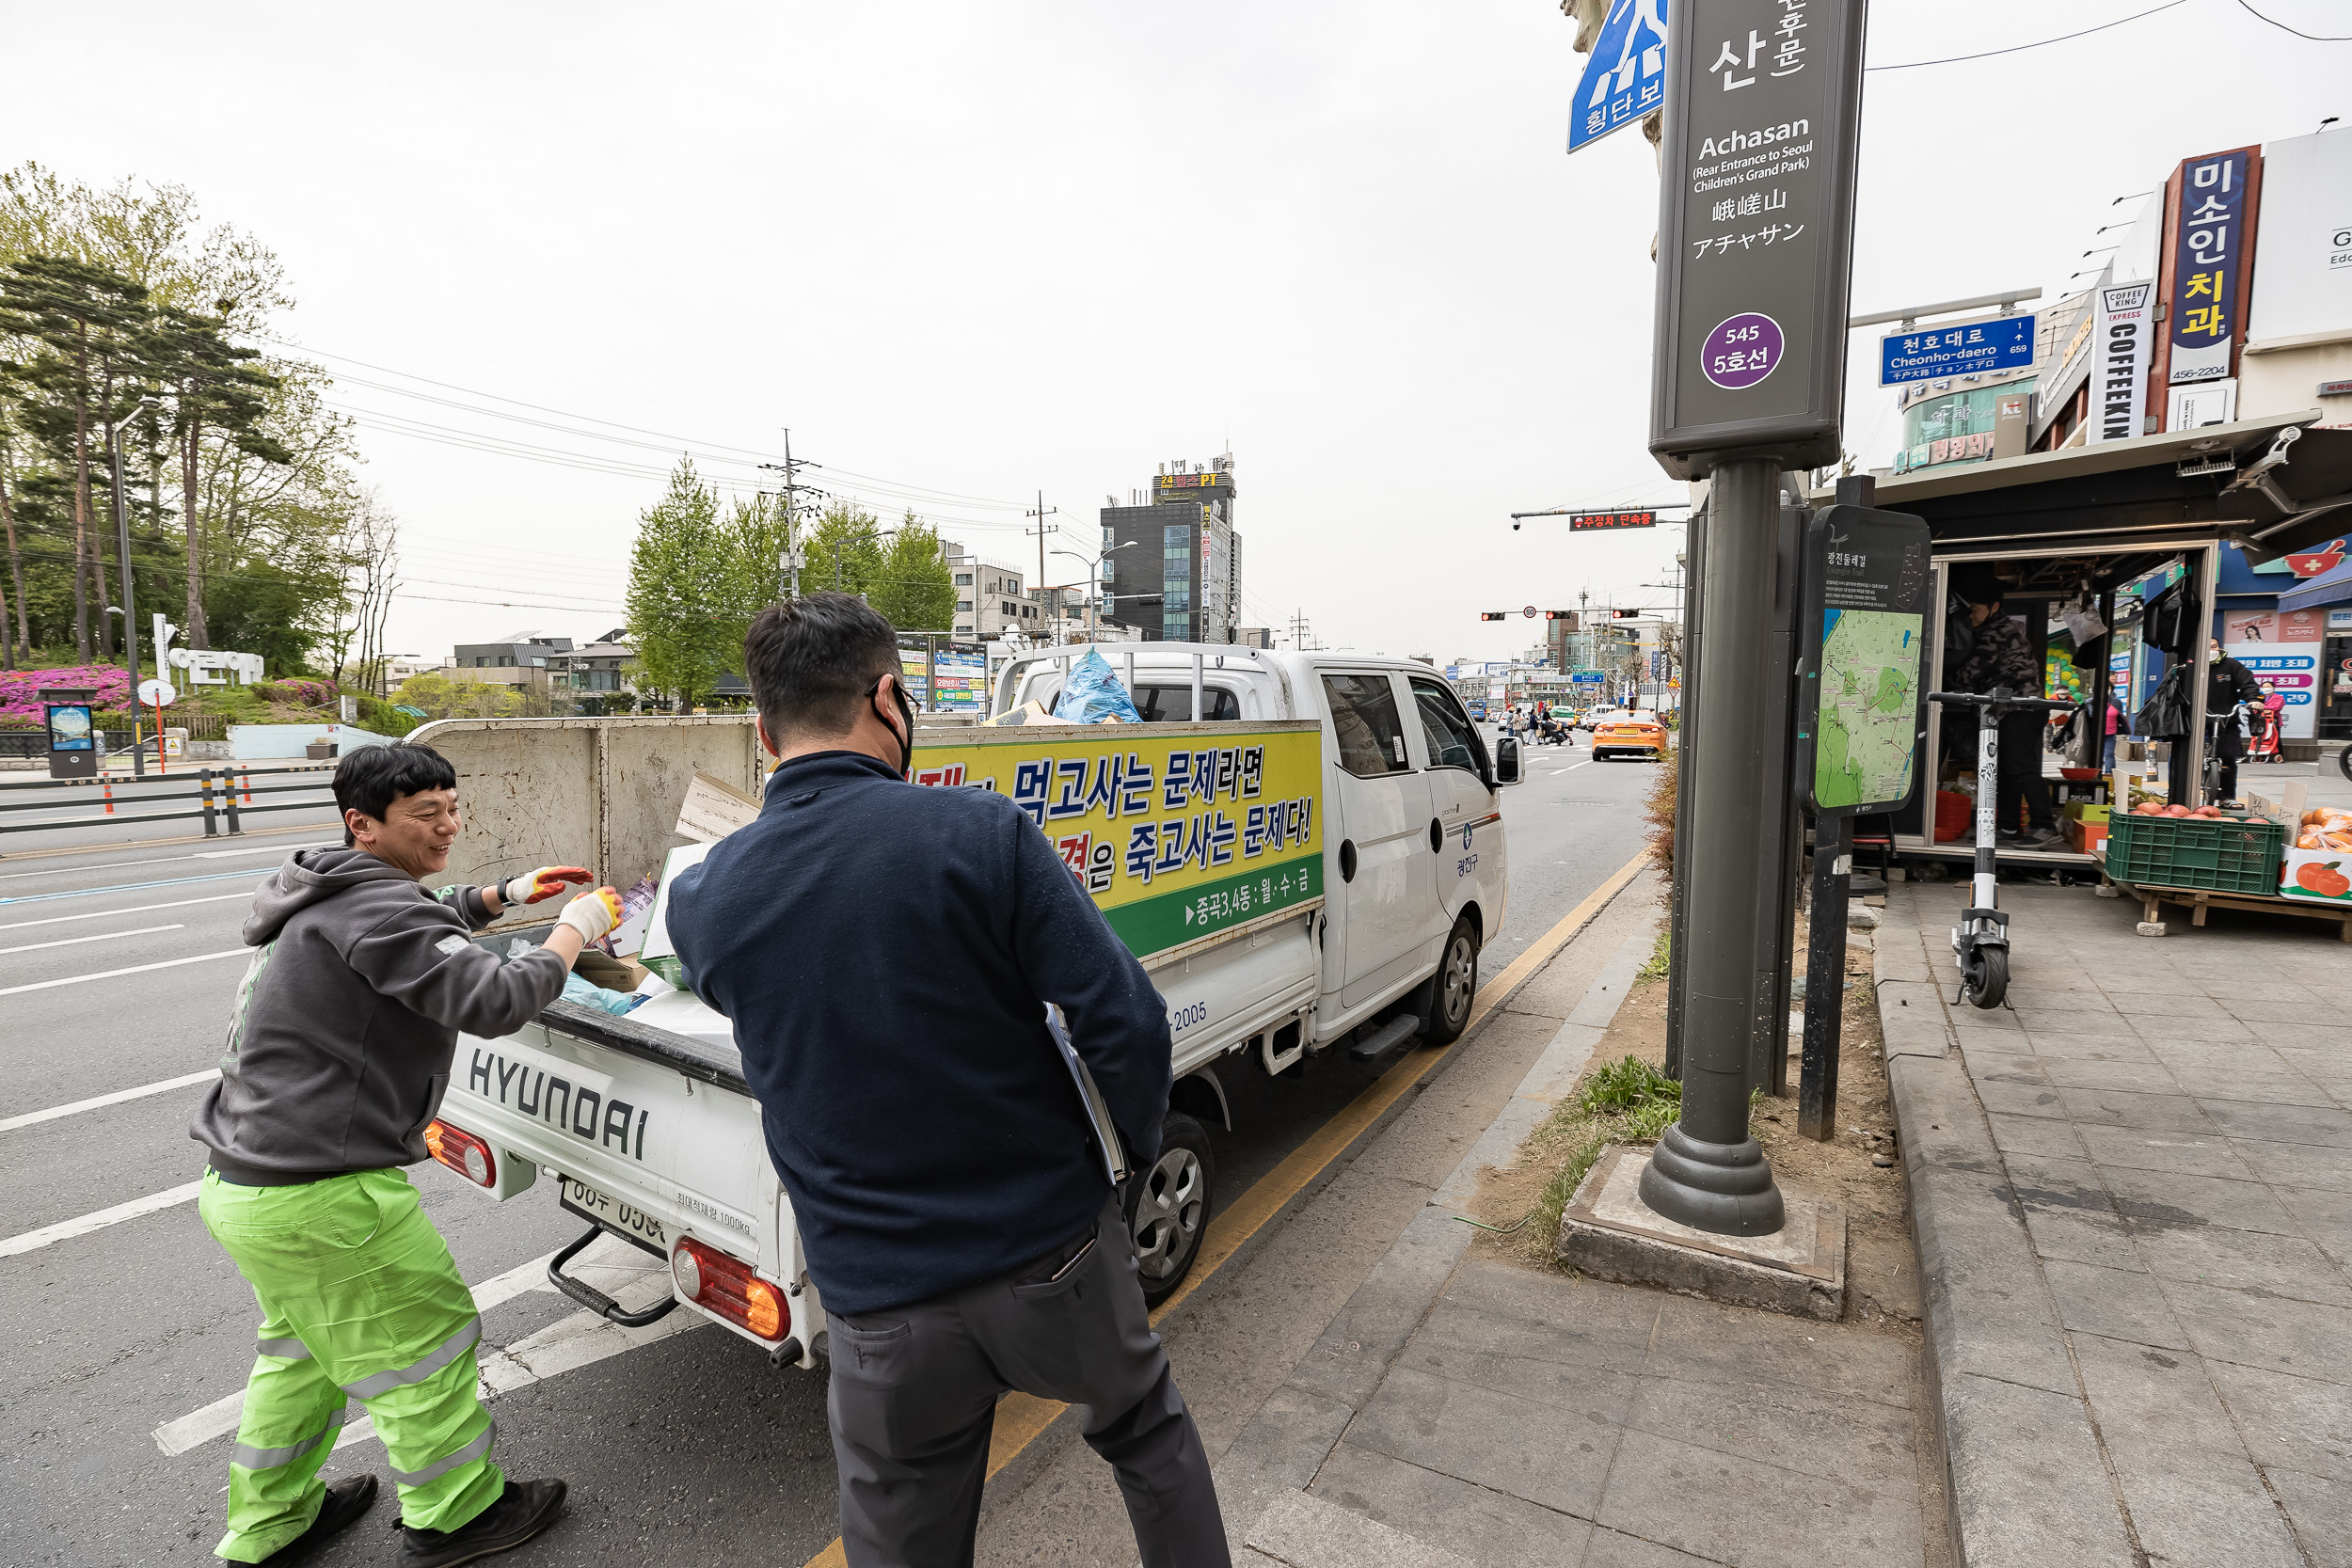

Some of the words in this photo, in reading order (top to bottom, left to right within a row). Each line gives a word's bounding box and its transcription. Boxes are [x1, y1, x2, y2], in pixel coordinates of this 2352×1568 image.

[1698, 117, 1810, 161] Achasan
[1692, 164, 1719, 181] (Rear
[1721, 153, 1767, 174] Entrance
[1768, 150, 1780, 163] to
[1782, 140, 1813, 159] Seoul
[1693, 171, 1744, 194] Children's
[1746, 166, 1779, 183] Grand
[1781, 157, 1810, 177] Park)
[1711, 188, 1787, 222] 峨嵯山
[1692, 222, 1805, 260] アチャサン
[2110, 289, 2142, 301] COFFEE
[2115, 297, 2137, 308] KING
[2108, 311, 2141, 322] EXPRESS
[1725, 325, 1760, 345] 545
[1903, 329, 1985, 355] 천호대로
[1890, 346, 1997, 369] Cheonho-daero
[2010, 344, 2027, 355] 659
[1713, 346, 1769, 375] 5호선
[1935, 359, 1994, 374] チョンホデロ
[2173, 365, 2226, 379] 456-2204
[2001, 401, 2022, 416] kt
[1200, 474, 1217, 486] PT
[1584, 515, 1613, 528] 주정차
[1620, 514, 1651, 526] 단속중
[1827, 552, 1867, 567] 광진둘레길
[2259, 659, 2282, 668] 처방
[2285, 658, 2309, 668] 조제
[2276, 677, 2299, 686] 조제
[1014, 753, 1153, 825] 먹고사는
[1163, 745, 1264, 809] 문제라면
[1126, 811, 1236, 882] 죽고사는
[1244, 797, 1312, 858] 문제다!
[1457, 853, 1478, 878] 광진구
[470, 1048, 649, 1162] HYUNDAI
[677, 1193, 718, 1220] 최대적재량
[720, 1212, 750, 1236] 1000kg
